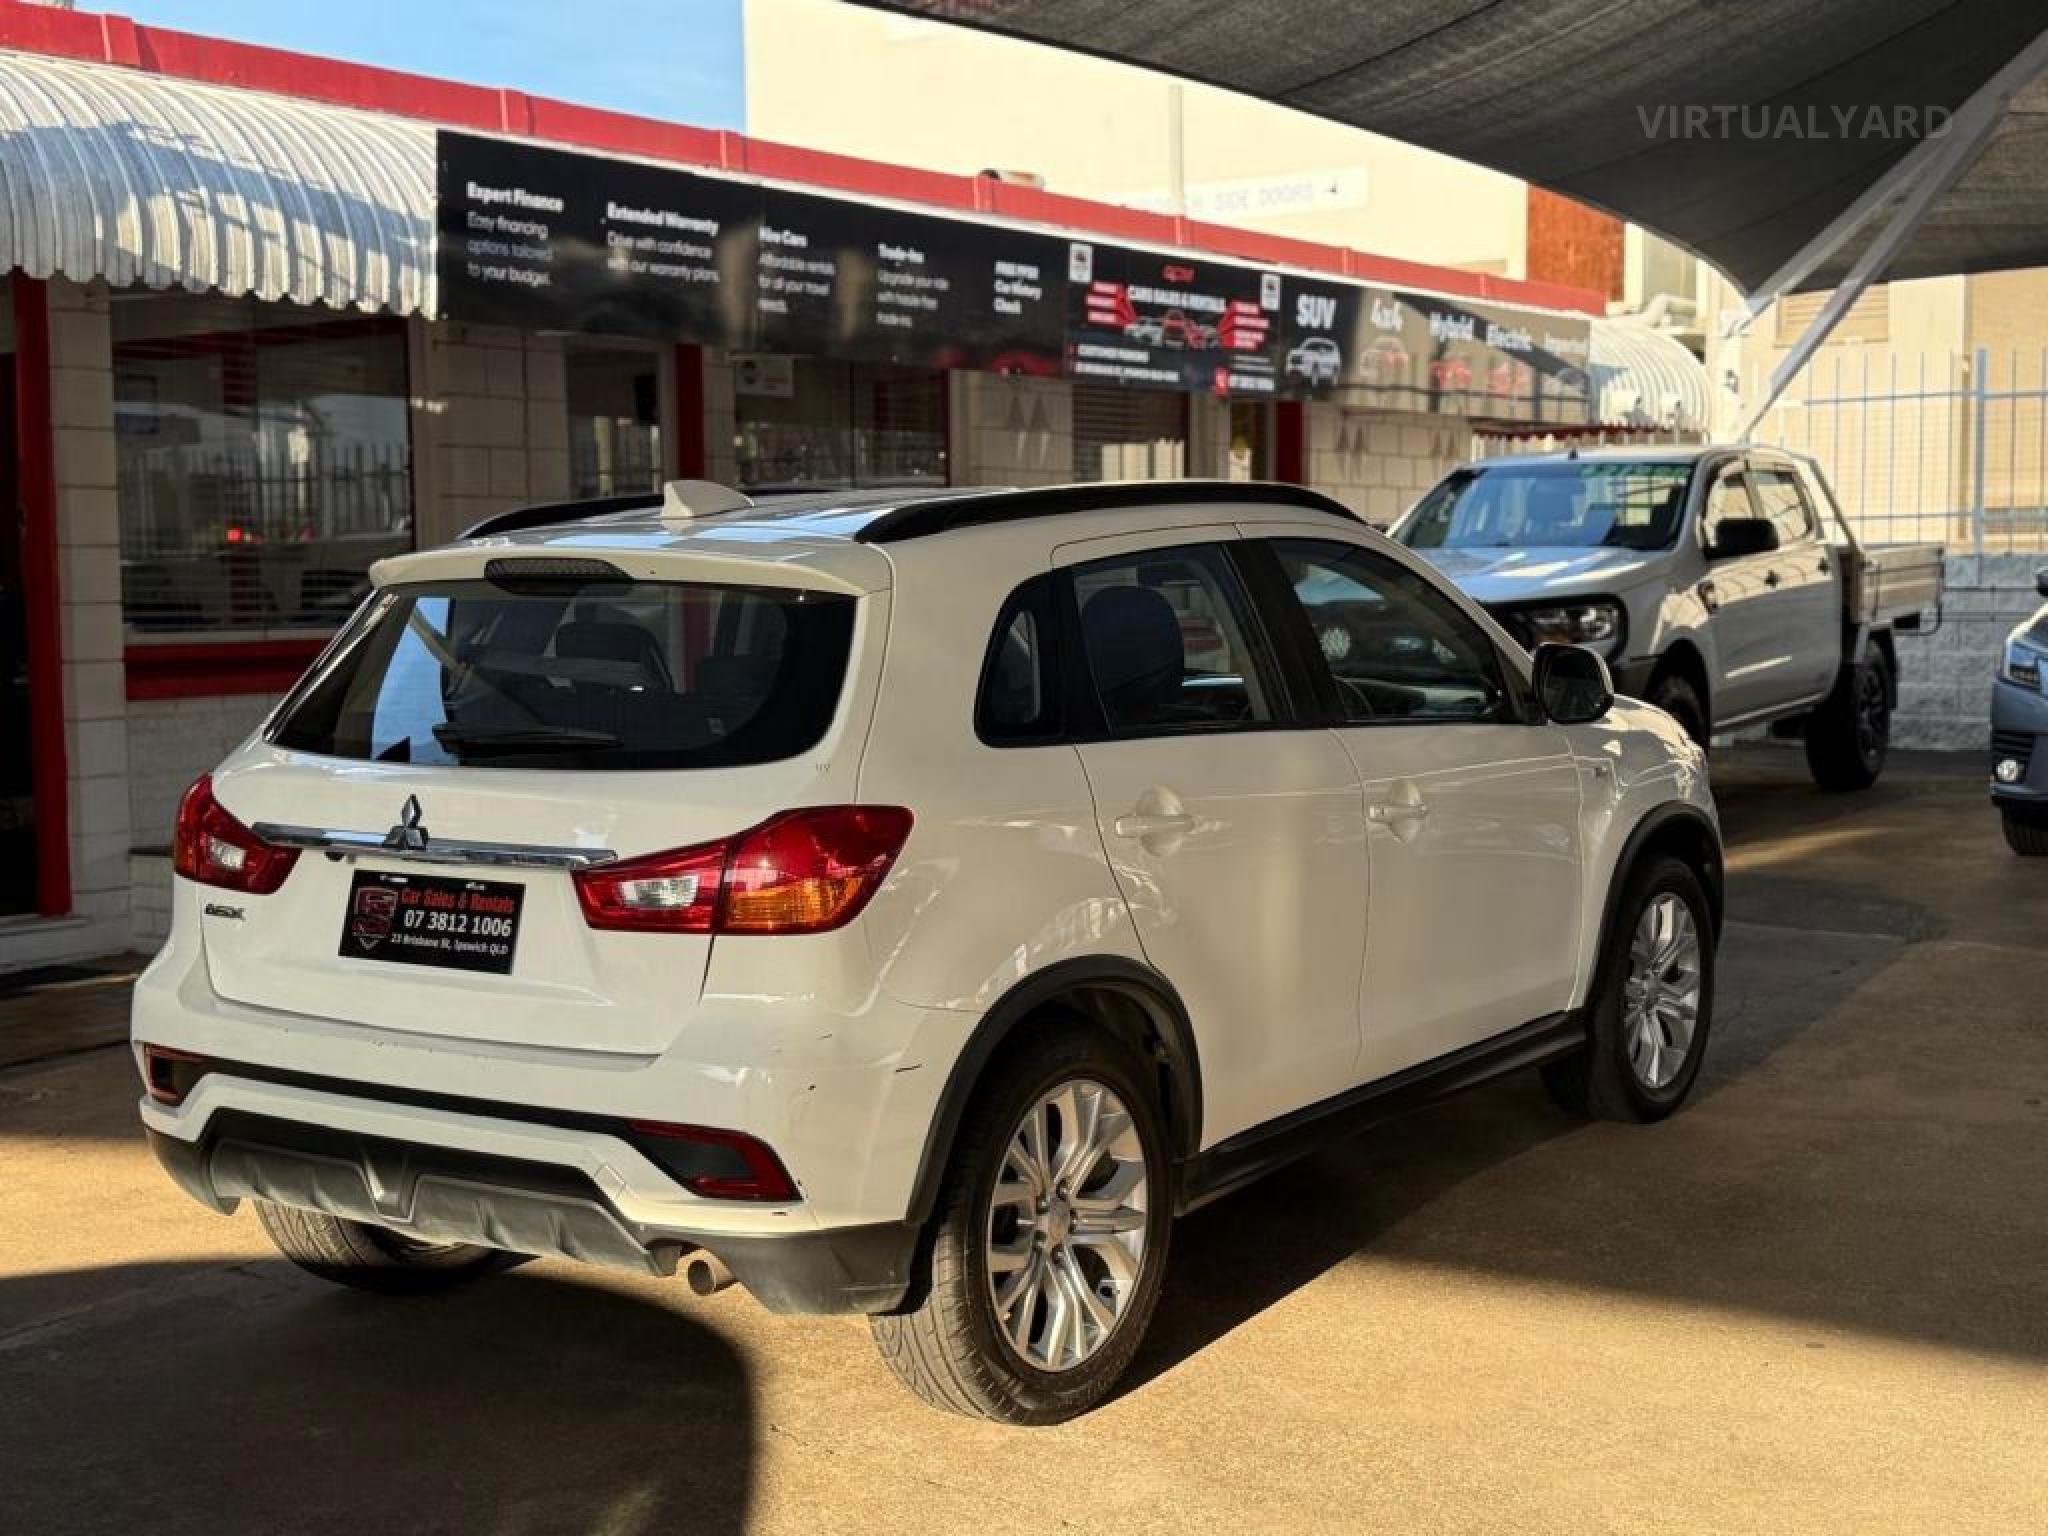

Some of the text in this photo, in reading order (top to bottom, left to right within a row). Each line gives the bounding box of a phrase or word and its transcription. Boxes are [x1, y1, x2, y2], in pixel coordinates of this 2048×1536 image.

[466, 181, 563, 211] Expert Finance
[607, 201, 719, 236] Extended Warranty
[1295, 294, 1336, 329] SUV
[1429, 312, 1474, 342] Hybrid
[1486, 322, 1532, 351] Electric
[424, 890, 454, 907] Sales
[404, 909, 512, 936] 07 3812 1006
